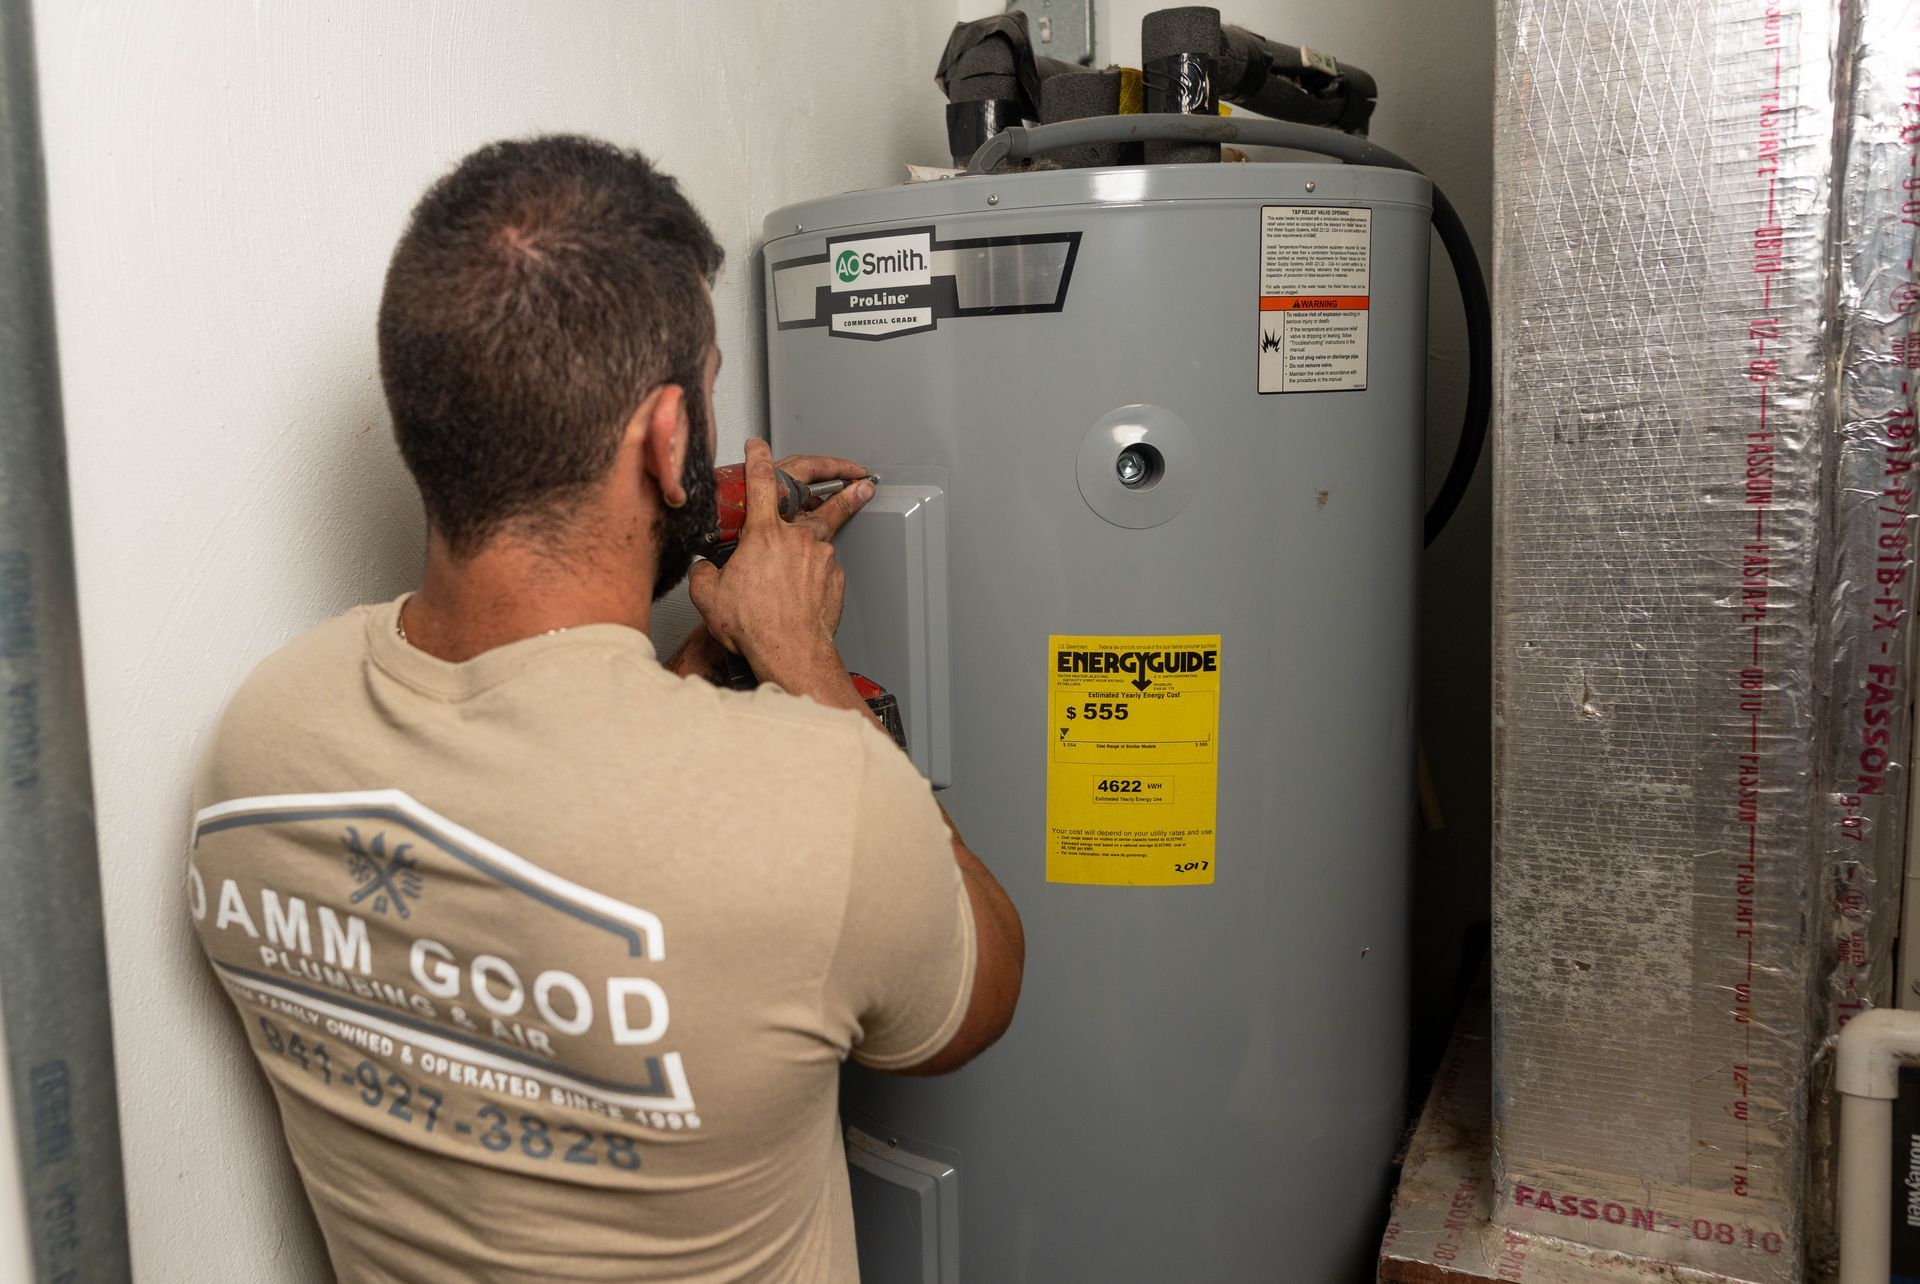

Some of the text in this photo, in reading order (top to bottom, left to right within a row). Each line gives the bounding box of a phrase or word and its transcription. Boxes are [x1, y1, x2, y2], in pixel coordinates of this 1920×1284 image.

[1302, 300, 1337, 308] WARNING
[1058, 651, 1217, 674] ENERGYGUIDE
[1143, 692, 1165, 700] Energy
[1066, 703, 1129, 721] $ 555
[1857, 663, 1898, 796] FASSON
[1098, 780, 1142, 793] 4622
[1097, 829, 1122, 837] depend
[1174, 861, 1209, 873] 2017
[259, 945, 556, 1058] PLUMBING & AIR
[409, 938, 670, 1046] GOOD
[325, 1018, 394, 1057] OWNED
[400, 1044, 414, 1066] &
[420, 1051, 541, 1099] OPERATED
[550, 1087, 625, 1121] SINCE
[1442, 1175, 1482, 1231] FASSON
